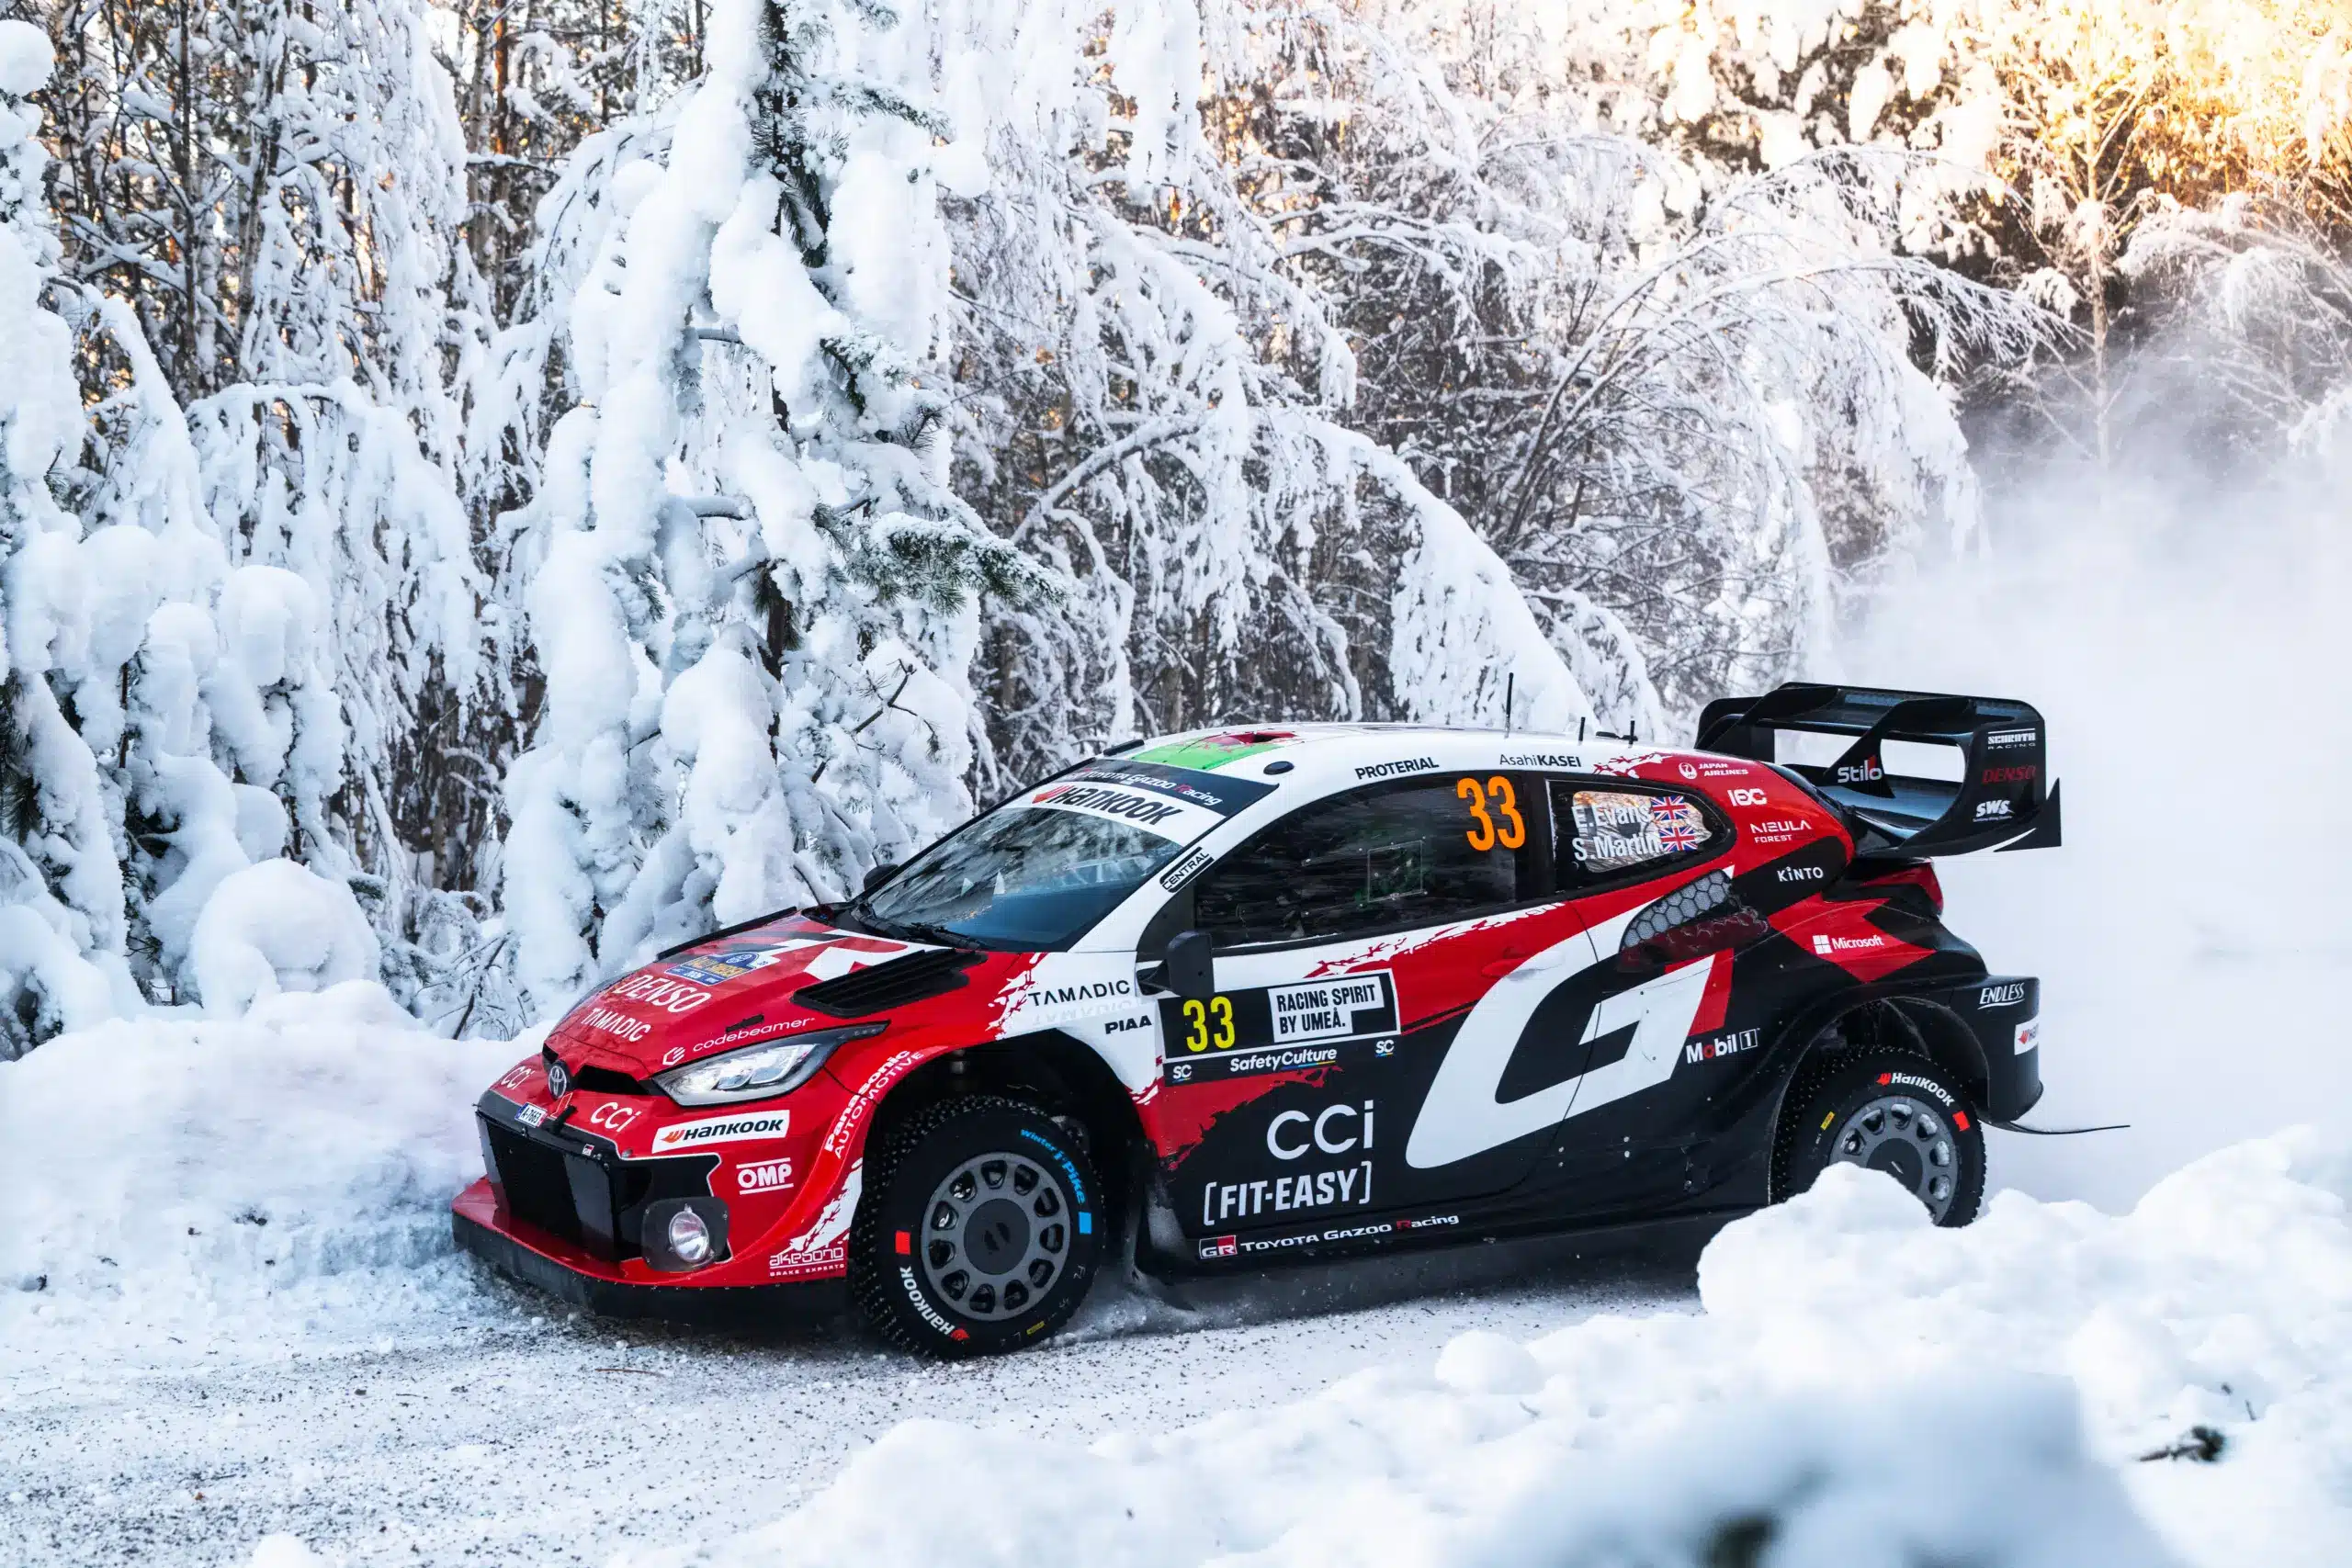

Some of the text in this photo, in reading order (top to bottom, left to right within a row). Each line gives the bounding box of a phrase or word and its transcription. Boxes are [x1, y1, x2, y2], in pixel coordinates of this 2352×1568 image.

[1987, 732, 2036, 745] SCHROTH
[1354, 757, 1440, 780] PROTERIAL
[1499, 753, 1582, 767] AsahiKASEI
[1838, 759, 1883, 784] Stilo
[1704, 769, 1749, 777] AIRLINES
[1982, 764, 2036, 784] DENSO
[1456, 775, 1526, 852] 33
[1571, 805, 1652, 827] E.Evans
[1975, 799, 2012, 818] SWS
[1572, 832, 1664, 862] S.Martin
[1754, 834, 1792, 843] FOREST
[1162, 852, 1210, 890] CENTRAL
[1831, 934, 1884, 950] Microsoft
[612, 974, 712, 1013] DENSO
[1028, 980, 1131, 1007] TAMADIC
[1276, 984, 1376, 1012] RACING SPIRIT
[1979, 982, 2025, 1004] ENDLESS
[581, 1008, 651, 1043] TAMADIC
[1104, 1015, 1153, 1035] PIAA
[1182, 996, 1236, 1052] 33
[1280, 1008, 1346, 1034] BY UMEÅ.
[692, 1017, 812, 1053] codebeamer
[1375, 1039, 1395, 1054] SC
[1685, 1033, 1738, 1065] Mobil
[1172, 1064, 1193, 1079] SC
[824, 1050, 910, 1152] Panasonic
[834, 1051, 924, 1159] AUTOMOTIVE
[738, 1163, 793, 1189] OMP
[1240, 1234, 1319, 1251] TOYOTA
[1323, 1224, 1392, 1241] GAZOO
[1396, 1214, 1460, 1231] Racing
[806, 1263, 845, 1273] EXPERTS
